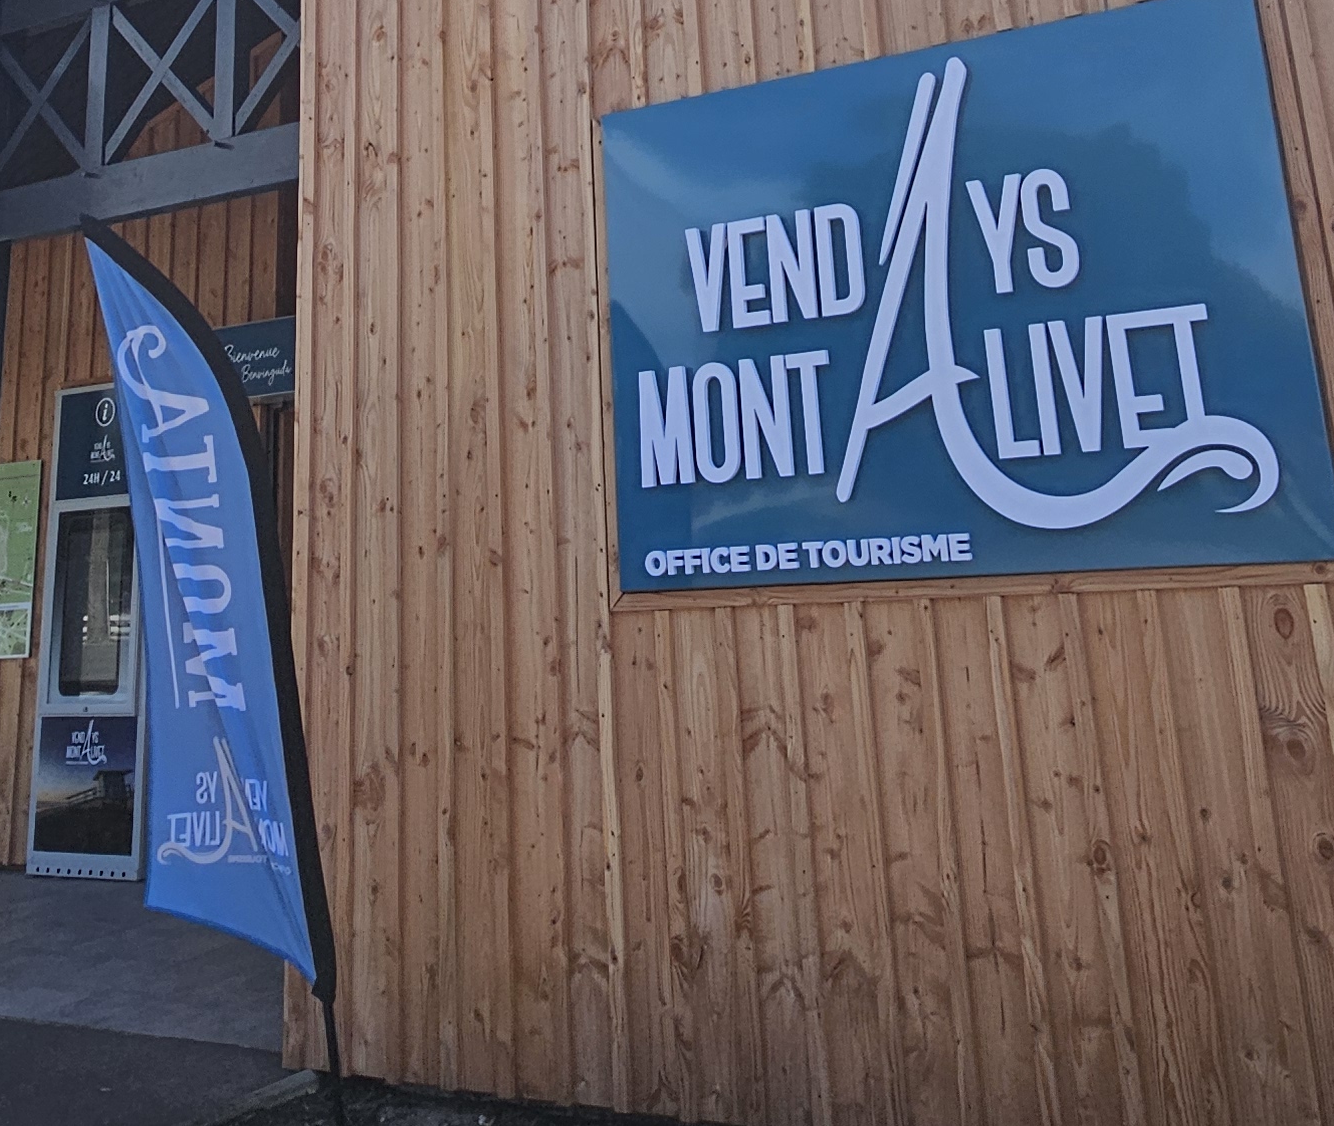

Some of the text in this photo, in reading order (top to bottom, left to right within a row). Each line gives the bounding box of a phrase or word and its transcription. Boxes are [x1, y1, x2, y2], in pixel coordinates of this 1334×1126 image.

[685, 56, 1081, 332] VENDAYS
[83, 472, 99, 485] 24H
[109, 470, 121, 482] 24
[639, 304, 1279, 529] MONTALIVET
[644, 533, 973, 577] OFFICE DE TOURISME
